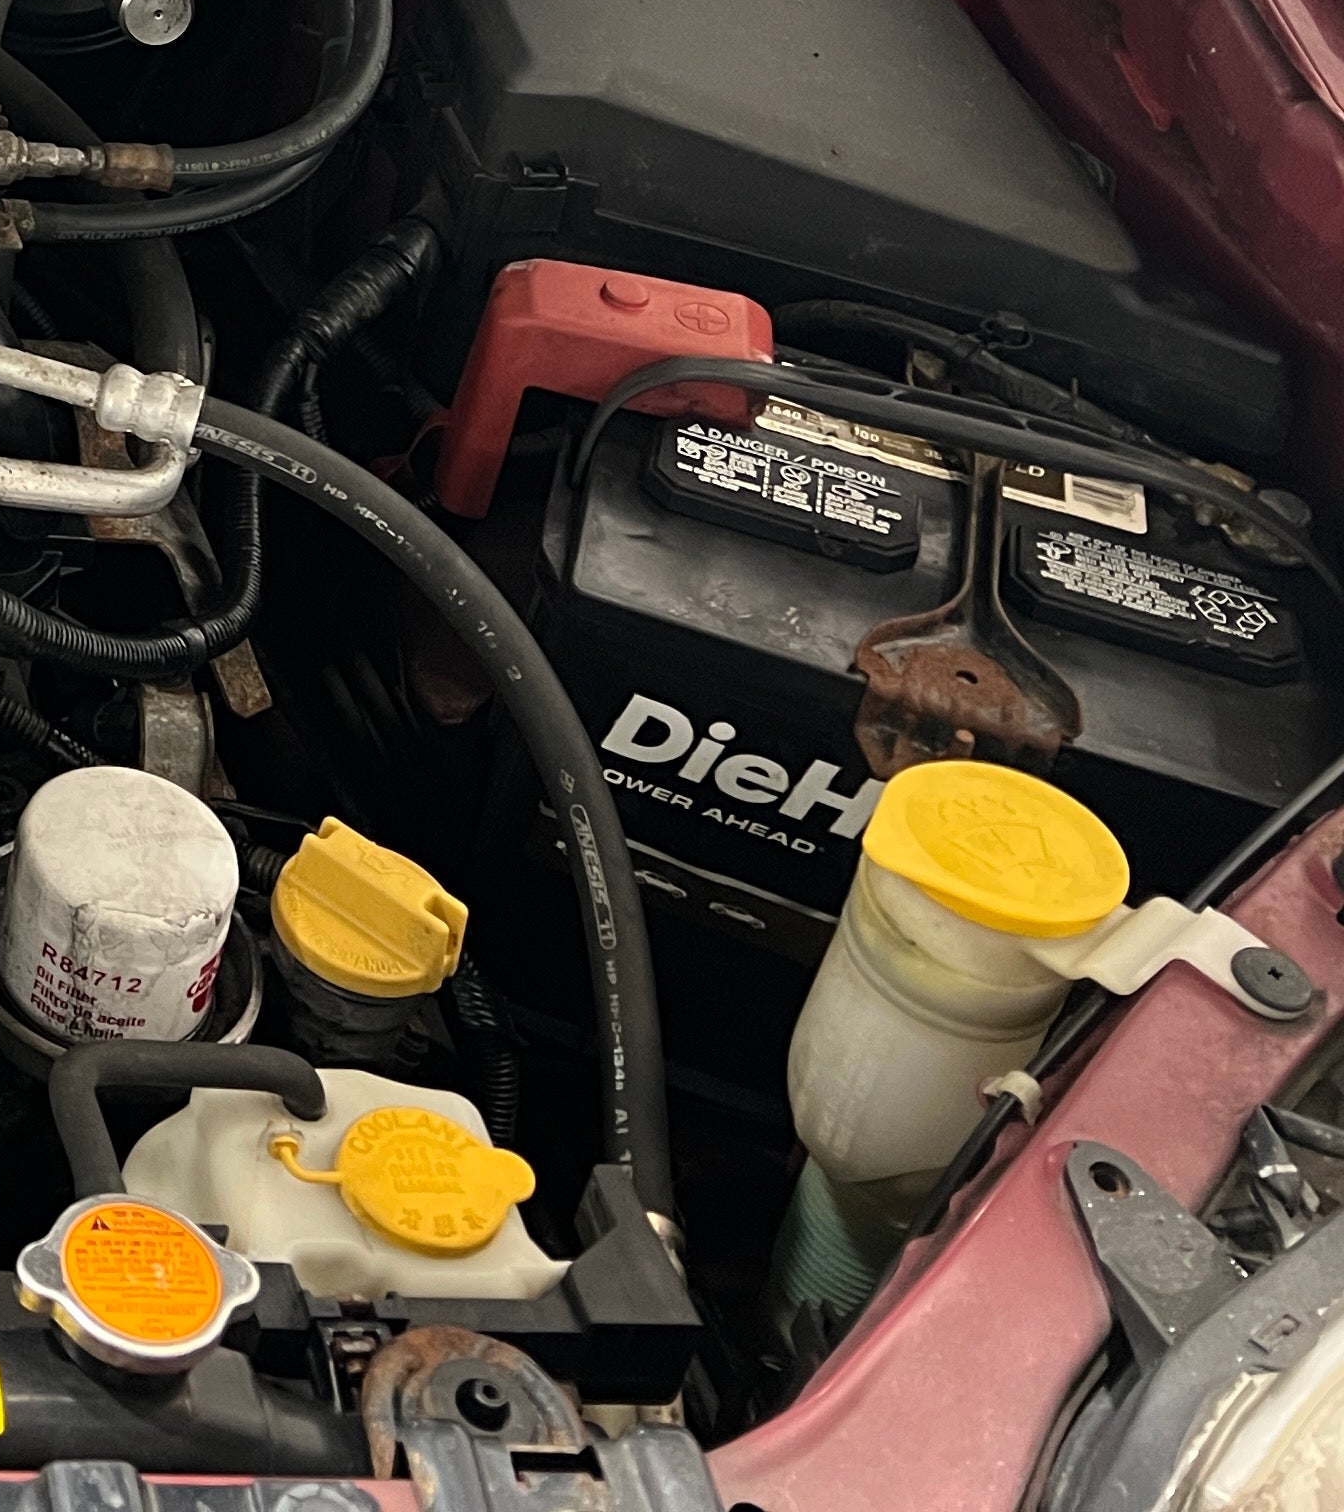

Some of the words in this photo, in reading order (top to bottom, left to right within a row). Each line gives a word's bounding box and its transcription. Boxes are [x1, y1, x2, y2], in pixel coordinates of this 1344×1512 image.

[708, 428, 789, 460] DANGER
[811, 457, 887, 488] POISON
[702, 807, 815, 855] AHEAD
[36, 965, 54, 985] Oil
[58, 979, 98, 1006] Filter
[41, 941, 143, 994] R84712
[30, 993, 66, 1024] Filtre
[33, 979, 69, 1010] Filtro
[97, 1010, 146, 1028] aceite
[347, 1111, 479, 1155] COOLANT
